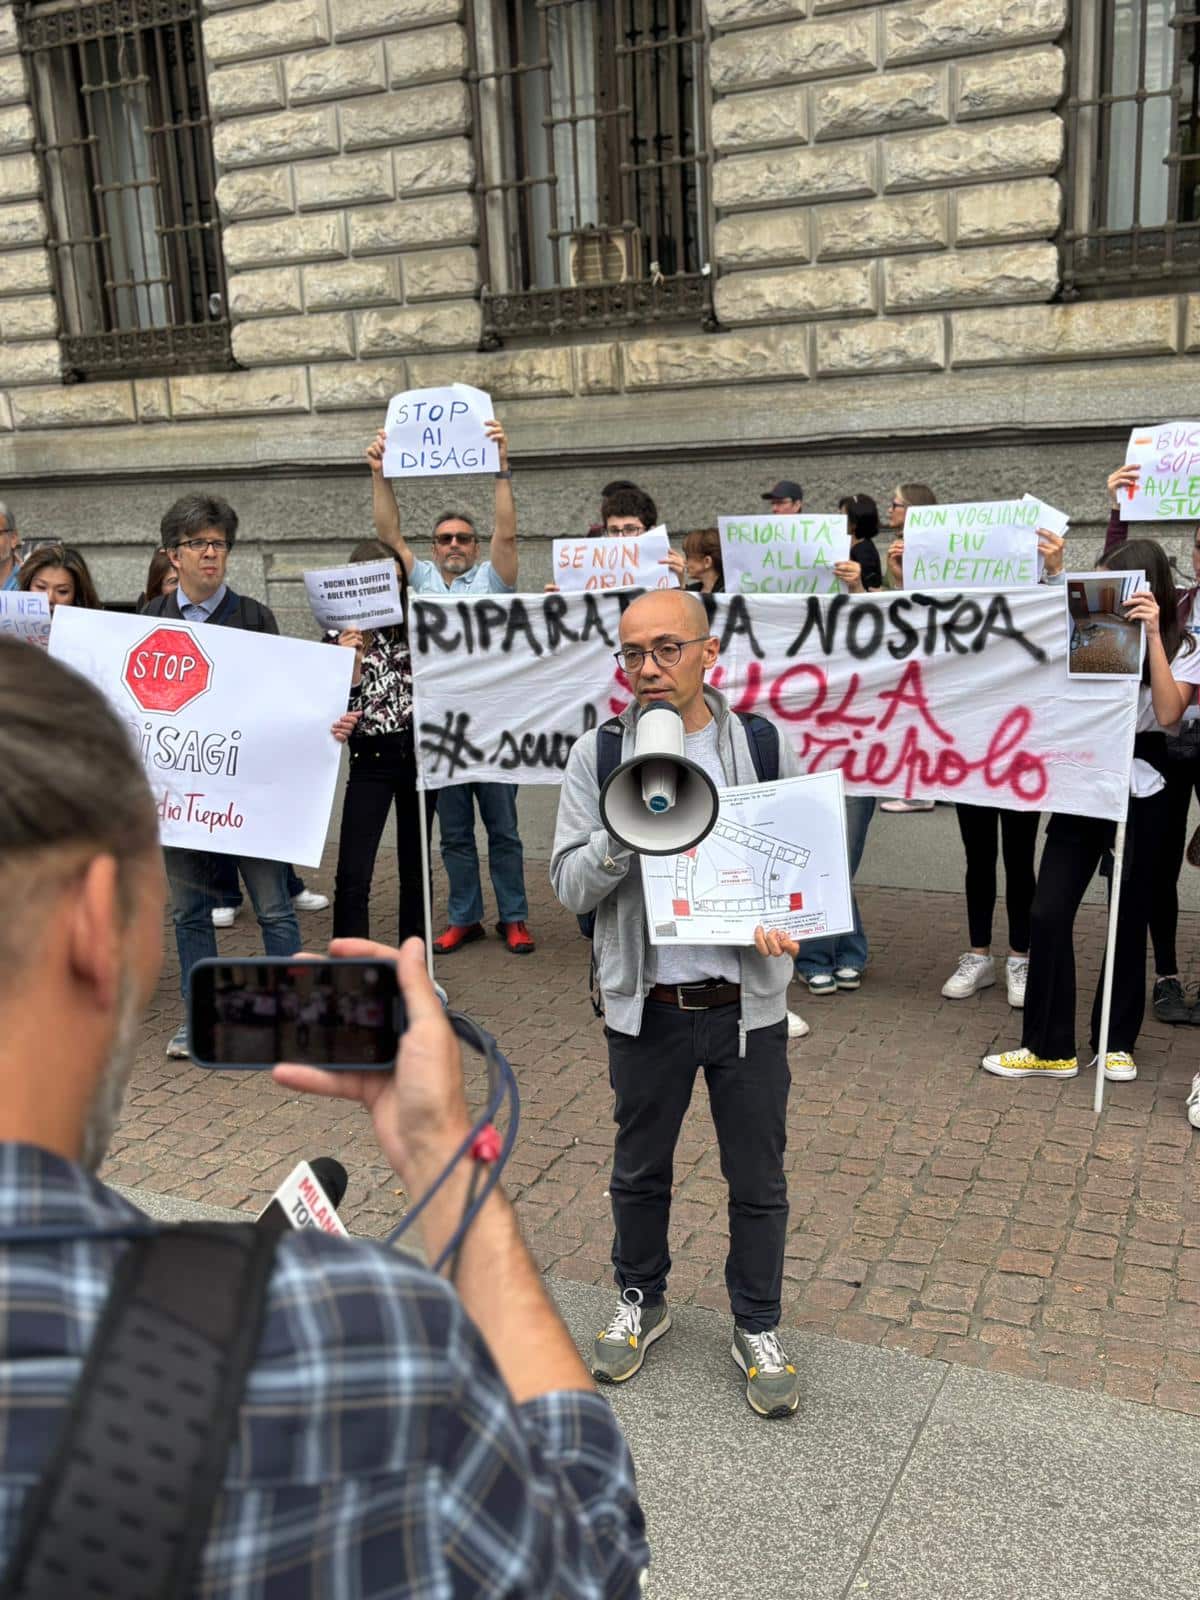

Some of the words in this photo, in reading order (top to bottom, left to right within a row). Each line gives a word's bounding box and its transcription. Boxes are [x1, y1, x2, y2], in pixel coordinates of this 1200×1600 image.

[395, 401, 469, 424] STOP
[423, 427, 442, 446] AI
[401, 446, 485, 469] DISAGI
[910, 510, 948, 529] NON
[956, 504, 1041, 528] VOGLIAMO
[558, 544, 588, 569] SE
[592, 543, 640, 570] NON
[762, 546, 832, 571] ALLA
[359, 572, 391, 585] SOFFITTO
[911, 556, 1034, 585] ASPETTARE
[327, 591, 344, 600] AULE
[345, 590, 358, 599] PER
[358, 583, 391, 597] STUDIARE
[412, 588, 648, 656] RIPARAT
[787, 592, 1047, 663] NOSTRA
[133, 651, 196, 682] STOP
[799, 706, 1048, 802] Tiepolo
